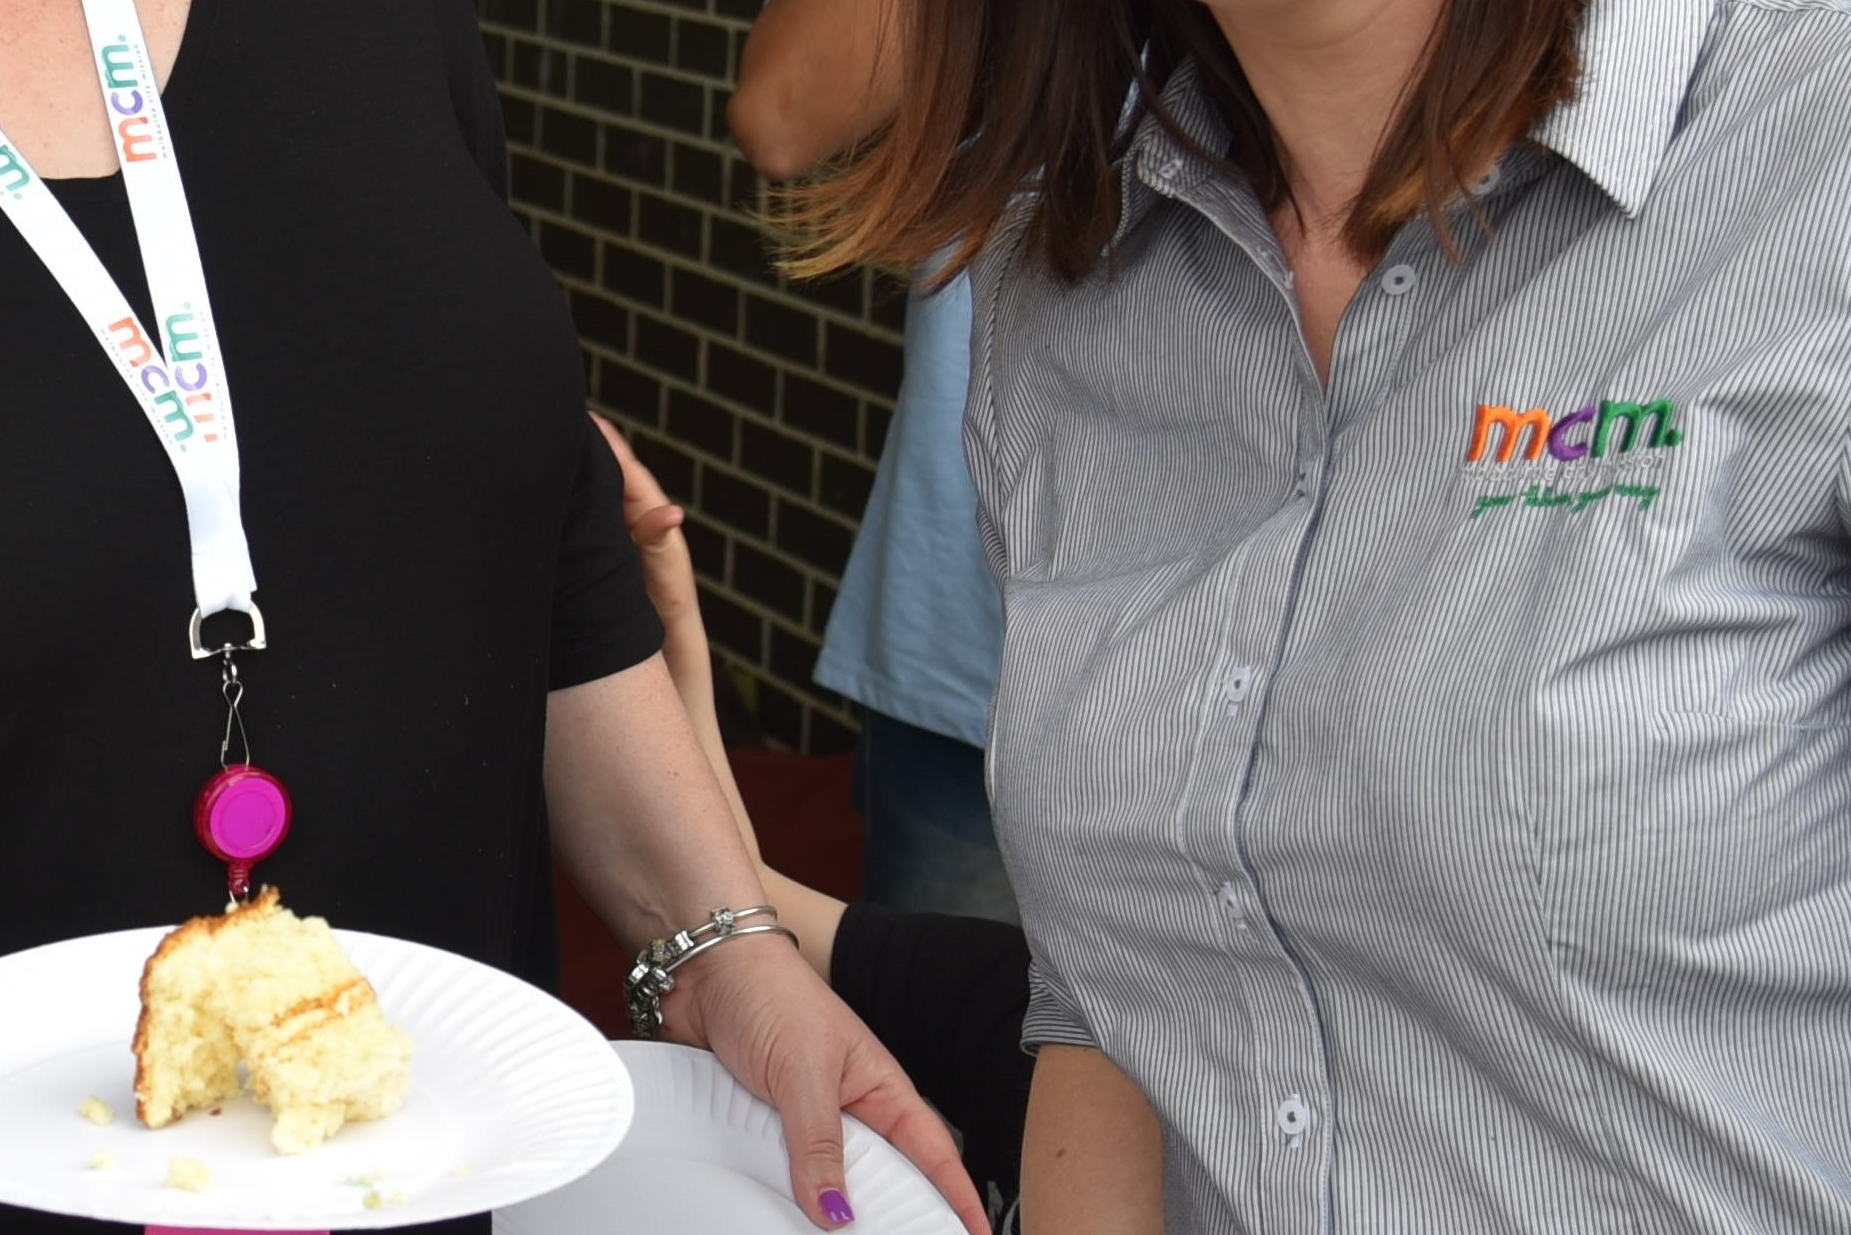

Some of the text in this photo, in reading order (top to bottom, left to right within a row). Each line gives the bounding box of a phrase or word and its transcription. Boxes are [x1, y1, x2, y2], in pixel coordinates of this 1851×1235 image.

[101, 34, 157, 162] mcm.
[108, 316, 194, 452] mcm.
[1466, 396, 1684, 463] mcm.
